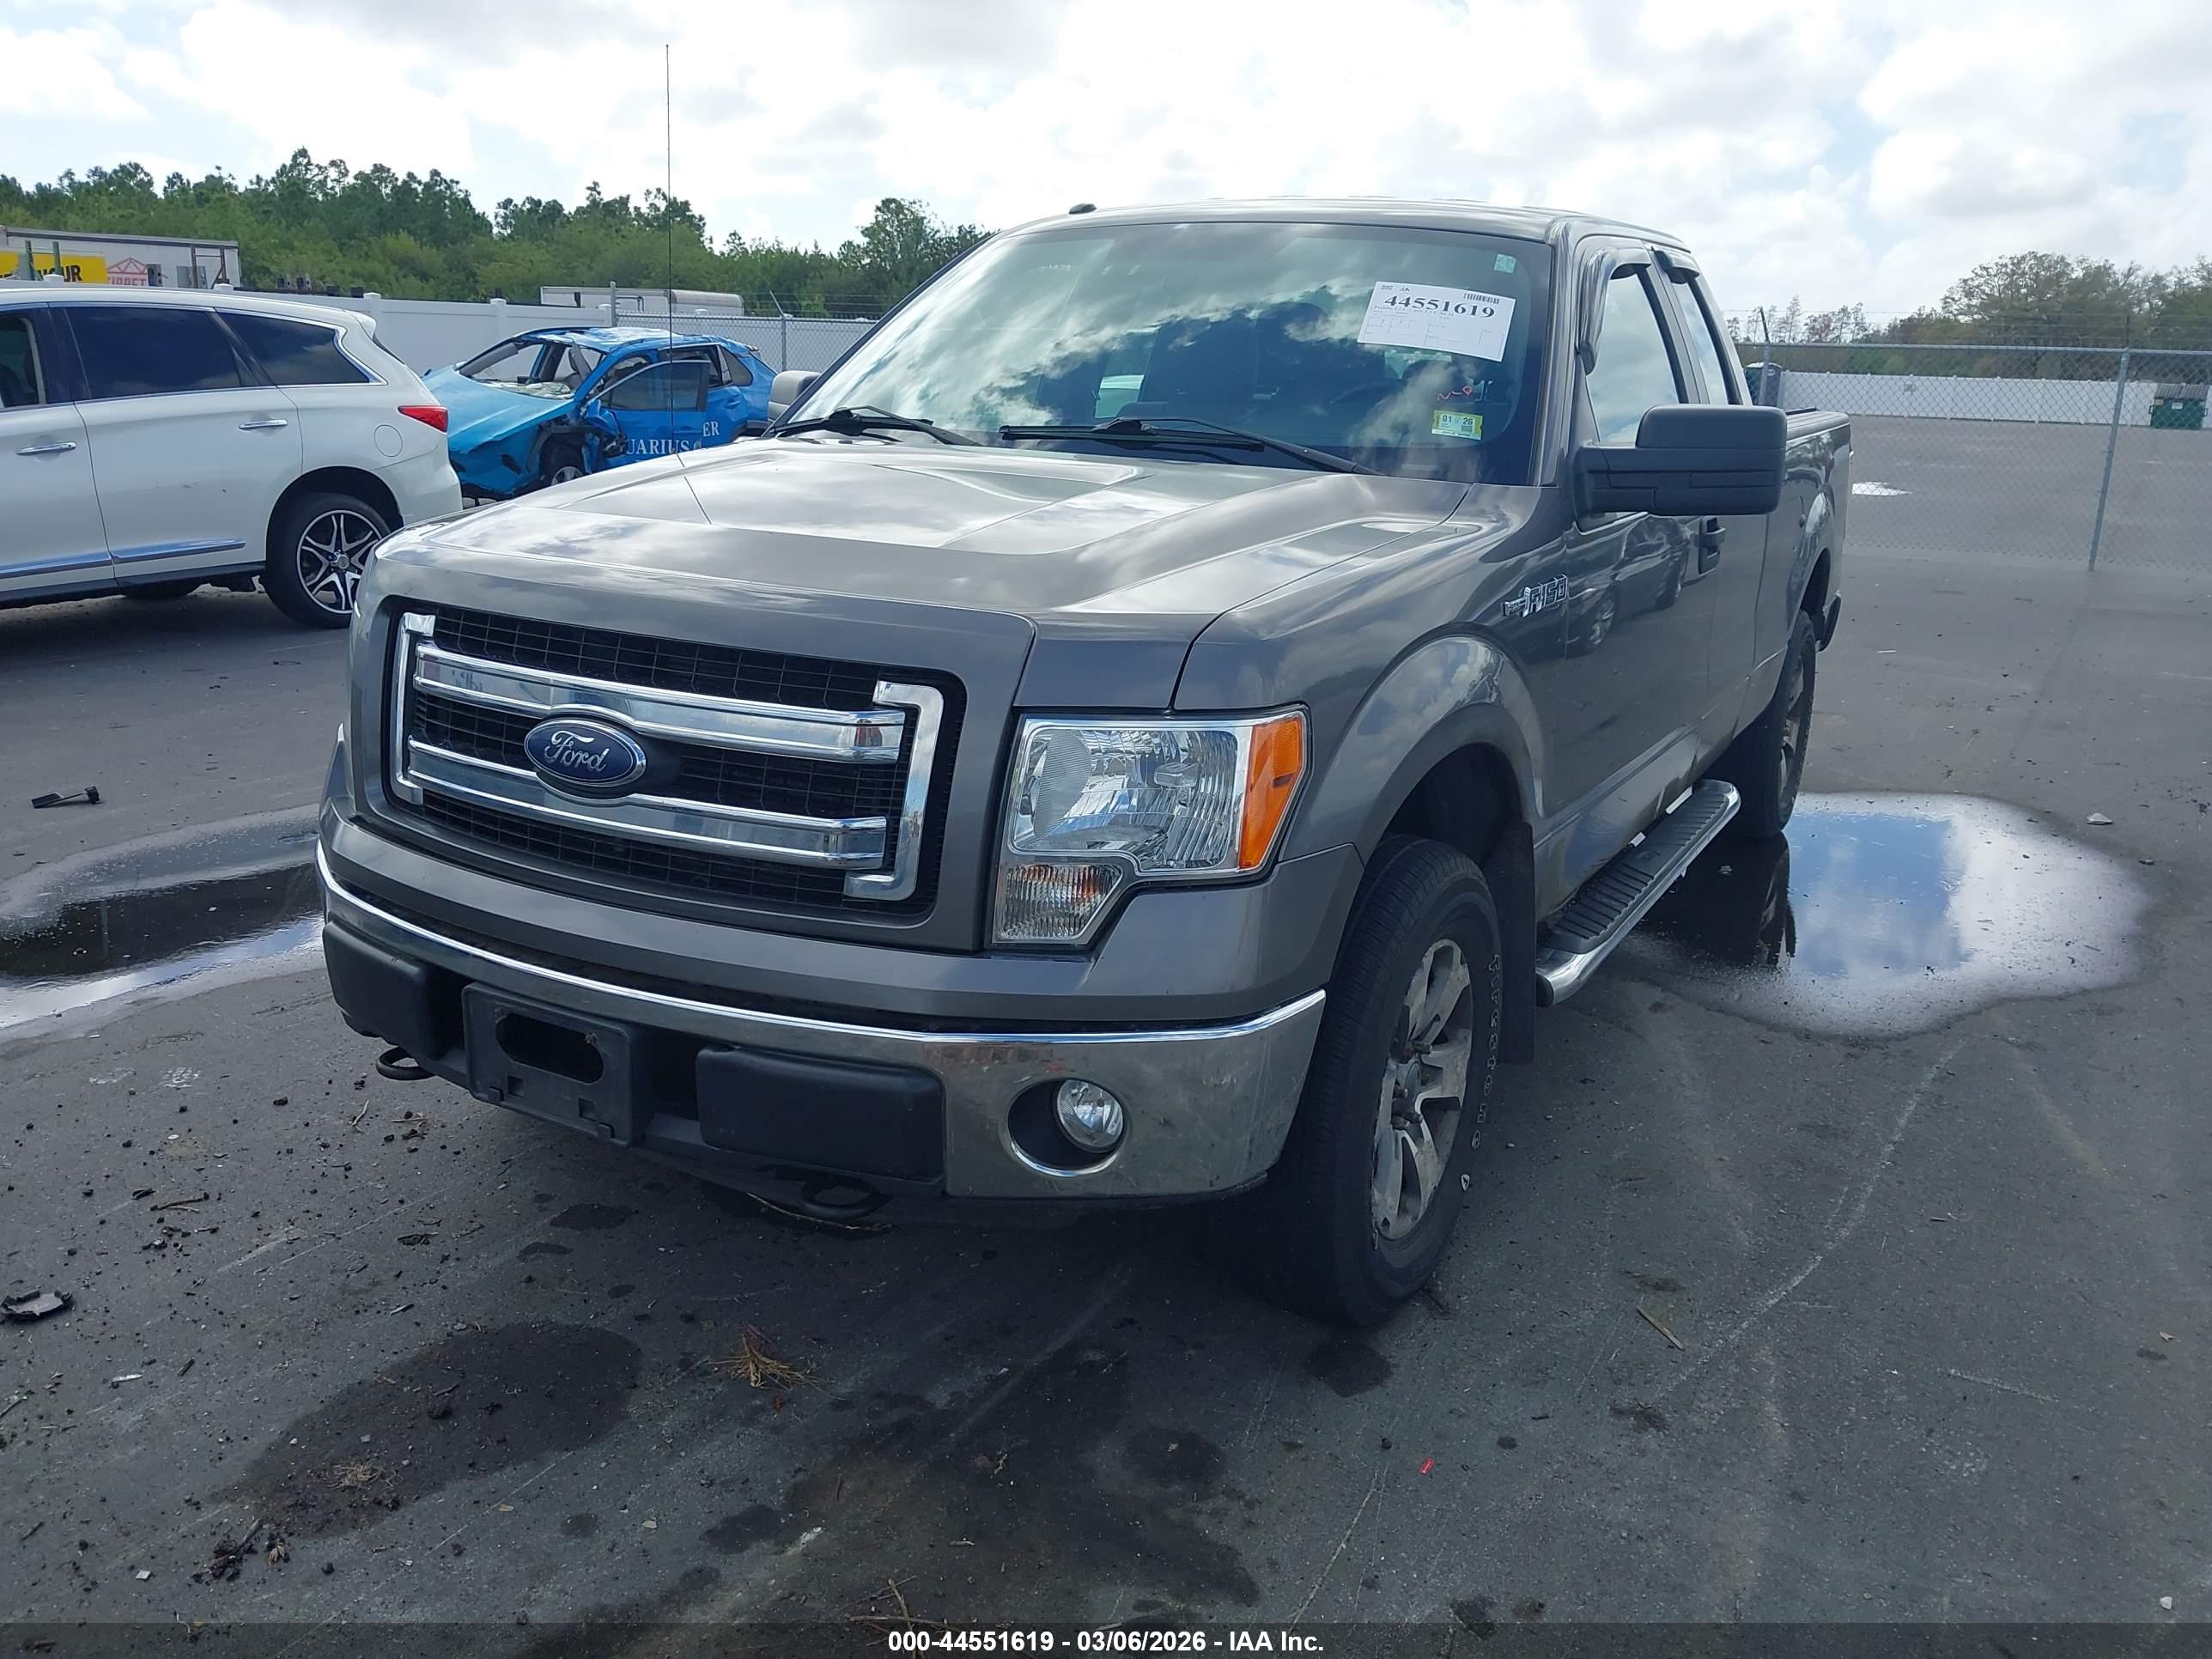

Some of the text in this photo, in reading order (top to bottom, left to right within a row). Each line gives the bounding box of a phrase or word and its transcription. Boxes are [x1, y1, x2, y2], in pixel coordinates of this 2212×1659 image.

[1384, 295, 1496, 319] 44551619
[702, 421, 720, 437] ER
[626, 439, 690, 455] UARIUS
[543, 730, 611, 773] Ford
